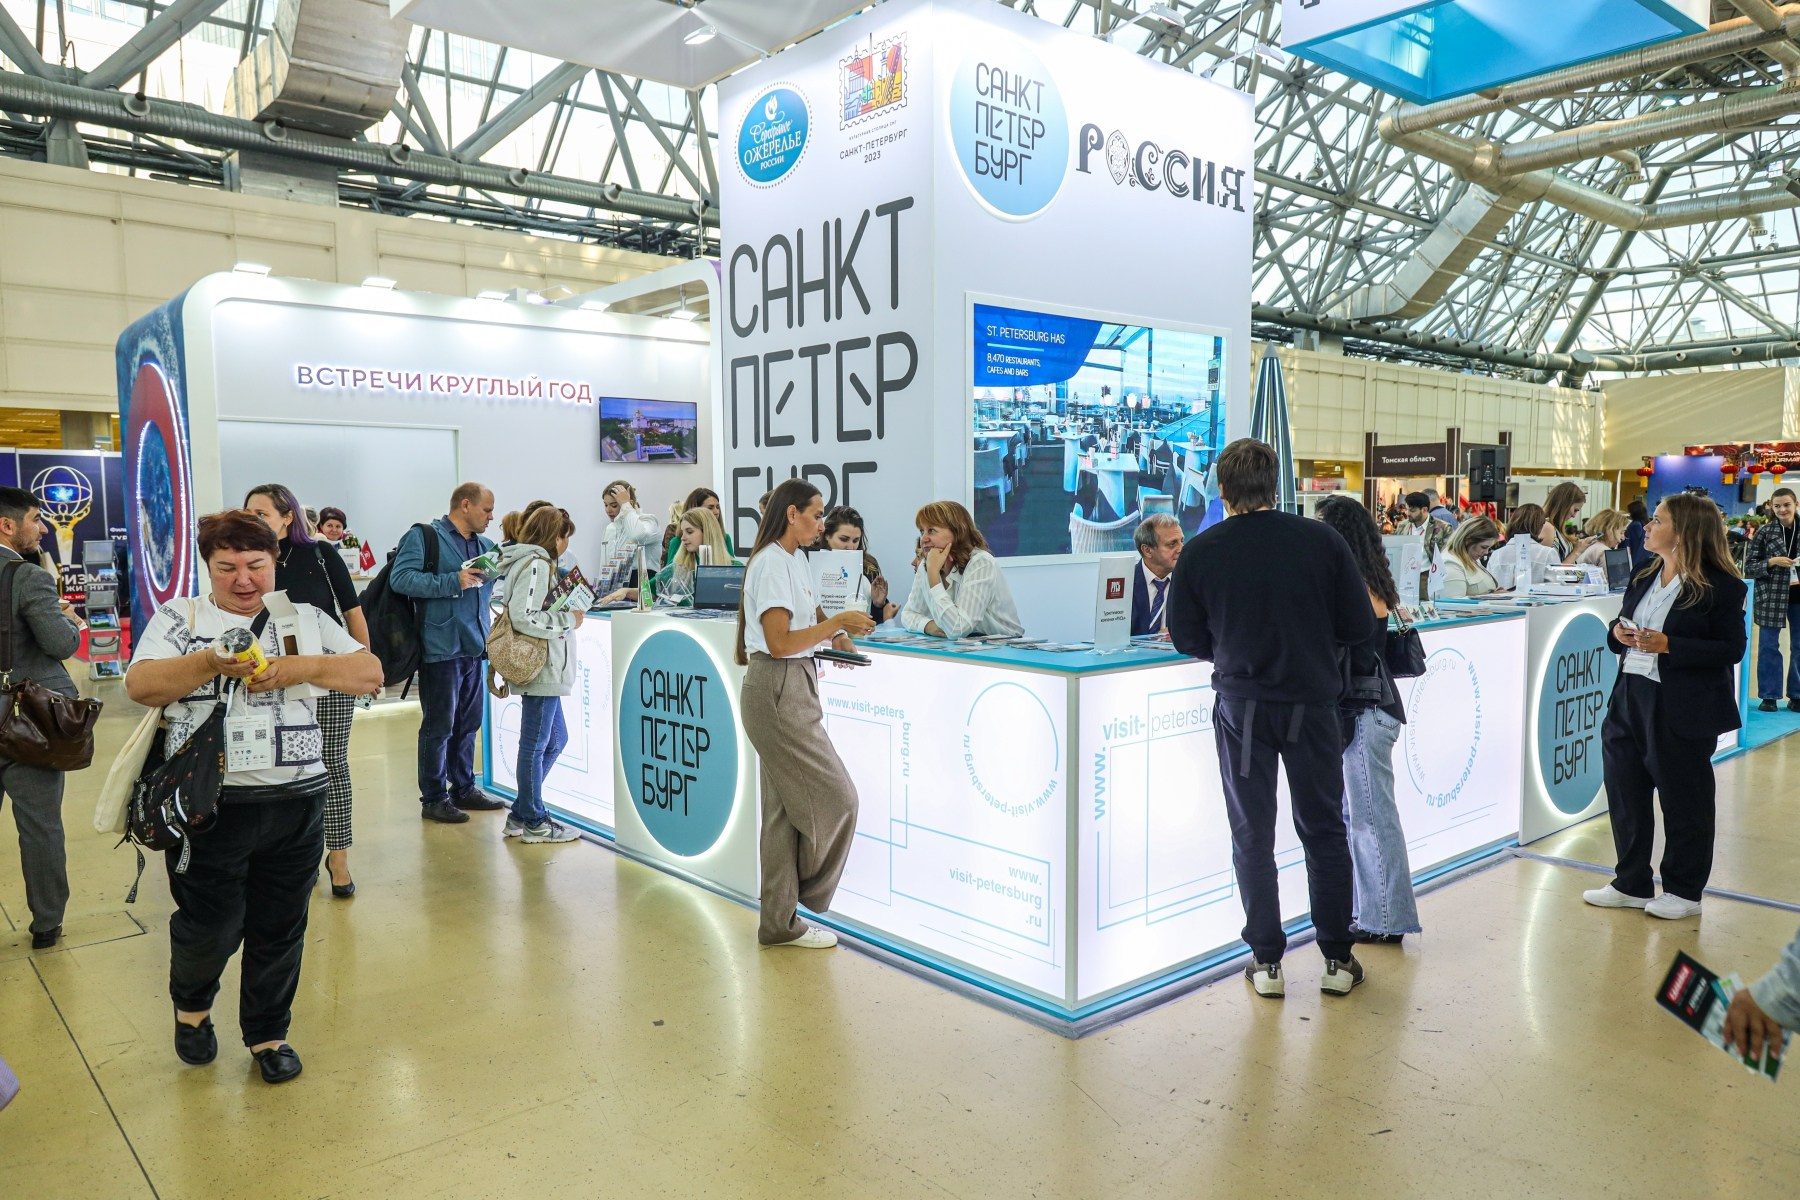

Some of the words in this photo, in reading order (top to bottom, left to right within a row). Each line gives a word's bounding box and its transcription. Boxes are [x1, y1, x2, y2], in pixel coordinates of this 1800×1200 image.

[975, 62, 1045, 114] САНКТ
[743, 130, 802, 166] ОЖЕРЕЛЬЕ
[839, 128, 908, 160] САНКТ-ПЕТЕРБУРГ
[975, 100, 1046, 151] ПЕТЕР
[760, 155, 785, 170] РОССИИ
[864, 150, 881, 164] 2023
[975, 140, 1032, 185] БУРГ
[1076, 123, 1246, 212] РОССИЯ
[729, 196, 915, 338] САНКТ
[986, 325, 998, 337] ST.
[1000, 327, 1049, 343] PETERSBURG
[1050, 333, 1065, 345] HAS
[986, 352, 1004, 364] 8,470
[297, 365, 423, 392] ВСТРЕЧИ
[429, 374, 543, 399] КРУГЛЫЙ
[549, 382, 593, 404] ГОД
[731, 331, 919, 450] ПЕТЕР
[986, 366, 1003, 375] CAFES
[1003, 368, 1015, 376] AND
[1015, 369, 1029, 377] BARS
[1382, 456, 1409, 464] Томская
[1409, 455, 1436, 463] область
[640, 667, 708, 719] САНКТ
[1556, 646, 1605, 694] САНКТ
[827, 695, 905, 720] www.visit-peters
[1102, 714, 1146, 741] visit-
[1554, 690, 1604, 740] ПЕТЕР
[641, 715, 711, 769] ПЕТЕР
[901, 721, 912, 778] burg.ru
[1426, 661, 1483, 808] www.visit-petersburg.ru
[963, 733, 1058, 819] www.visit-petersburg.ru
[1553, 735, 1594, 785] БУРГ
[642, 763, 697, 816] БУРГ
[1094, 746, 1106, 821] www.
[949, 866, 1043, 911] visit-petersburg
[1008, 865, 1043, 886] www.
[1026, 913, 1042, 928] .ru
